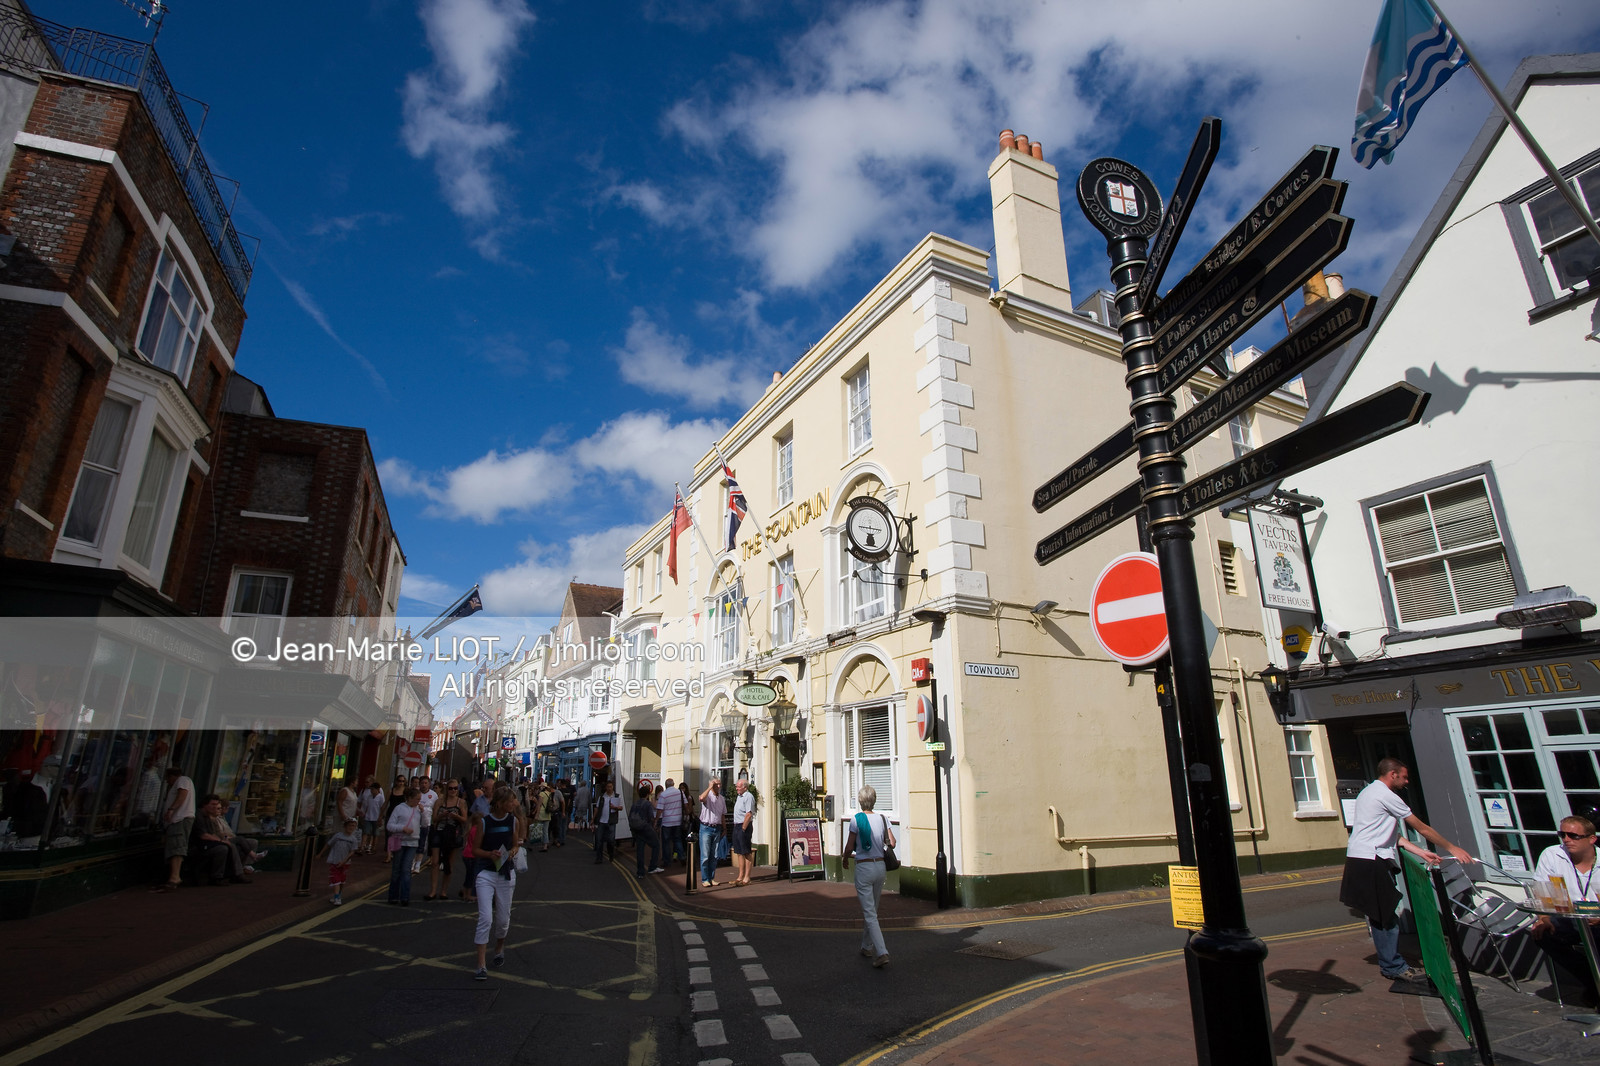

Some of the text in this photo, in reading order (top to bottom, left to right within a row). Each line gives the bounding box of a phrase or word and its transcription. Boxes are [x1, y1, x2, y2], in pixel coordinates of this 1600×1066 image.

[1095, 161, 1139, 181] COWES
[1087, 196, 1160, 236] TOWN COUNCIL
[1166, 276, 1239, 349] Police Station
[1170, 313, 1239, 376] Yacht Haven
[1286, 306, 1354, 364] Museum
[1037, 491, 1049, 505] Sea
[1191, 473, 1235, 503] Toilets
[861, 498, 886, 512] FOUNTAIN
[741, 486, 830, 562] THE FOUNTAIN
[1040, 535, 1064, 558] Tourist
[1065, 510, 1108, 543] Information
[1257, 523, 1297, 543] VECTIS
[1262, 539, 1296, 553] TAVERN
[1268, 594, 1310, 607] FREE HOUSE
[1286, 635, 1299, 645] ADT
[968, 665, 1016, 676] TOWN QUAY
[1490, 661, 1582, 697] THE
[1157, 684, 1165, 694] 4
[1332, 693, 1362, 707] Free
